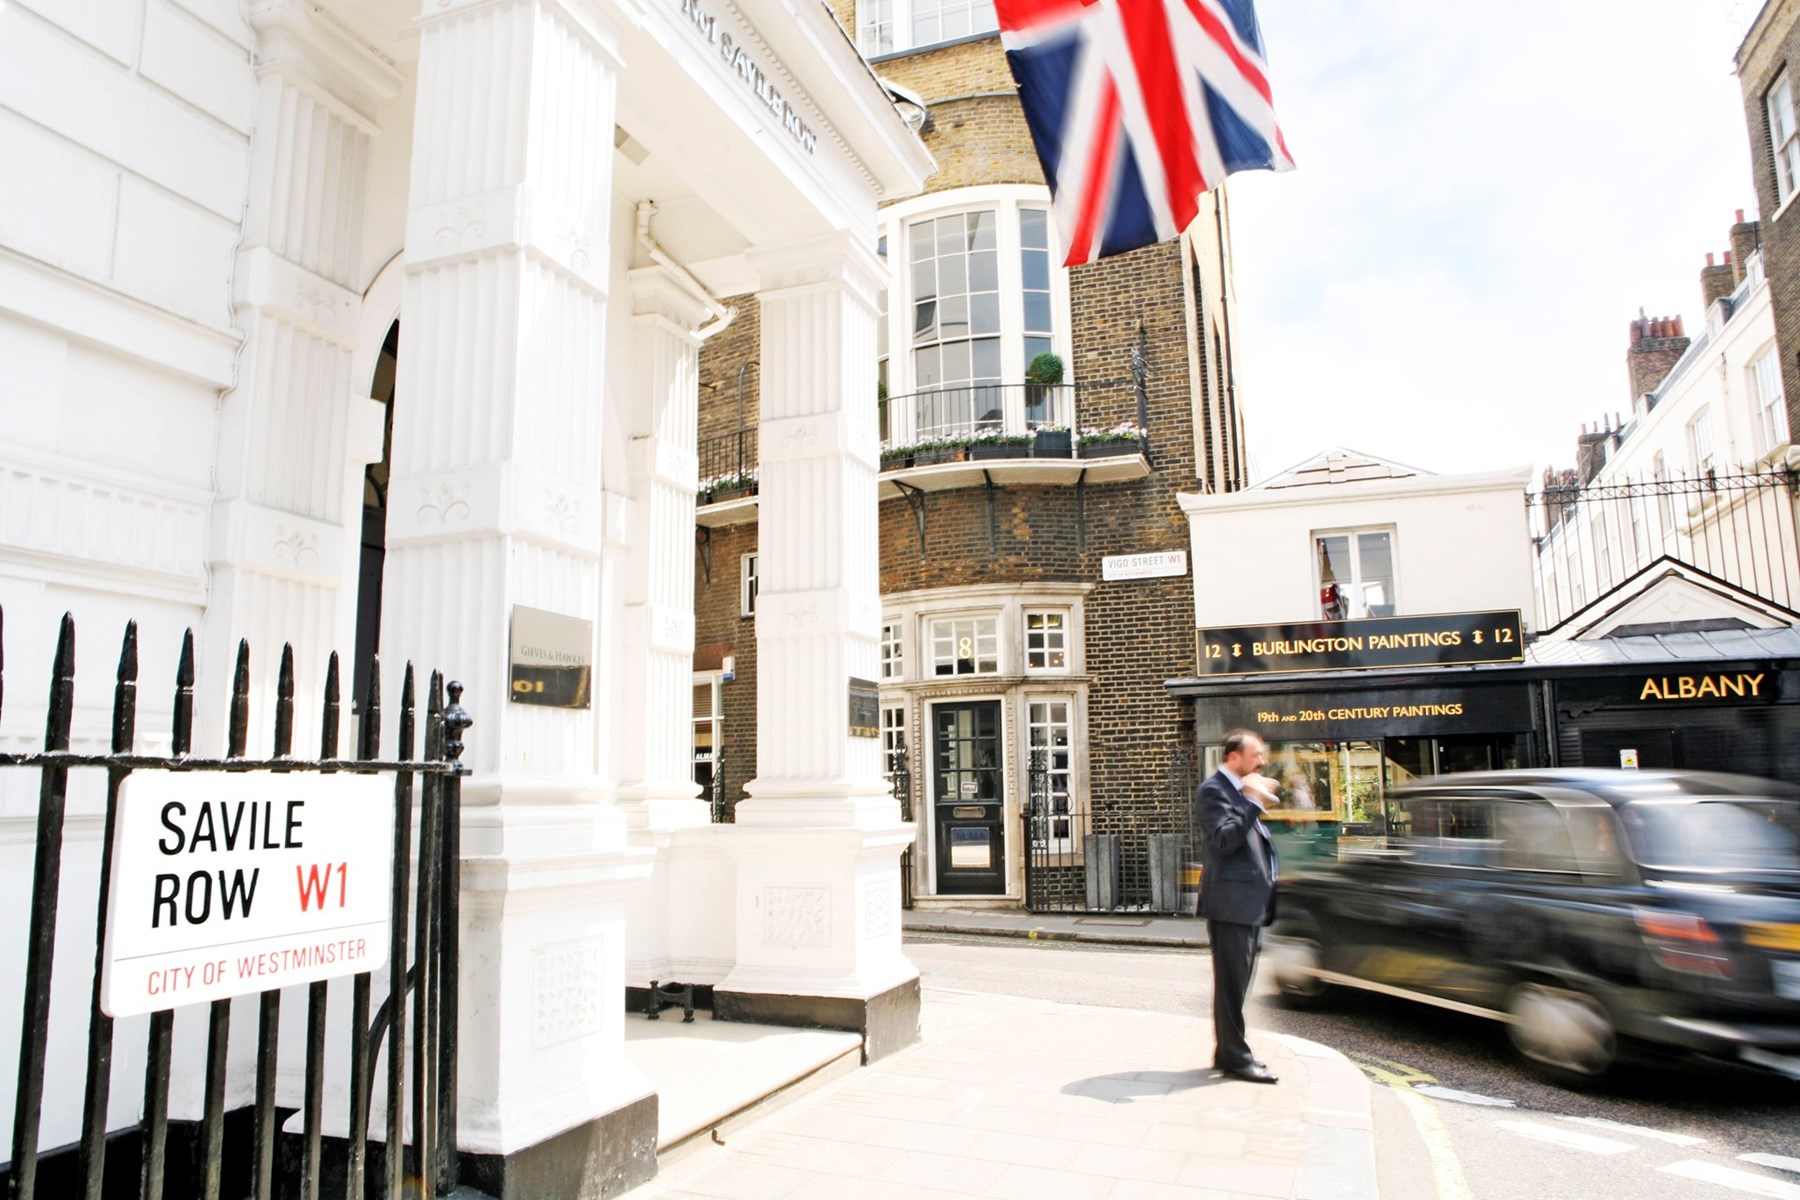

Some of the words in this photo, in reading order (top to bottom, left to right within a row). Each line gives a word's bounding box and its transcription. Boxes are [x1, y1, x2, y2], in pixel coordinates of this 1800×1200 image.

[782, 101, 817, 154] ROW
[1108, 559, 1129, 568] VIGO
[1132, 556, 1164, 567] STREET
[1167, 554, 1181, 565] W1
[521, 645, 547, 659] GIEVES
[547, 650, 554, 661] &
[555, 651, 585, 664] HAWKES
[958, 637, 972, 659] 8
[1205, 644, 1221, 659] 12
[1252, 636, 1363, 656] BURLINGTON
[1369, 631, 1462, 650] PAINTINGS
[1494, 628, 1514, 643] 12
[1640, 673, 1765, 700] ALBANY
[1257, 711, 1280, 723] 19th
[1299, 709, 1325, 722] 20th
[1328, 706, 1390, 720] CENTURY
[1392, 703, 1463, 718] PAINTINGS
[158, 800, 305, 856] SAVILE
[151, 867, 260, 928] ROW
[296, 861, 347, 912] W1
[147, 965, 195, 996] CITY
[203, 960, 227, 985] OF
[237, 938, 367, 979] WESTMINSTER
